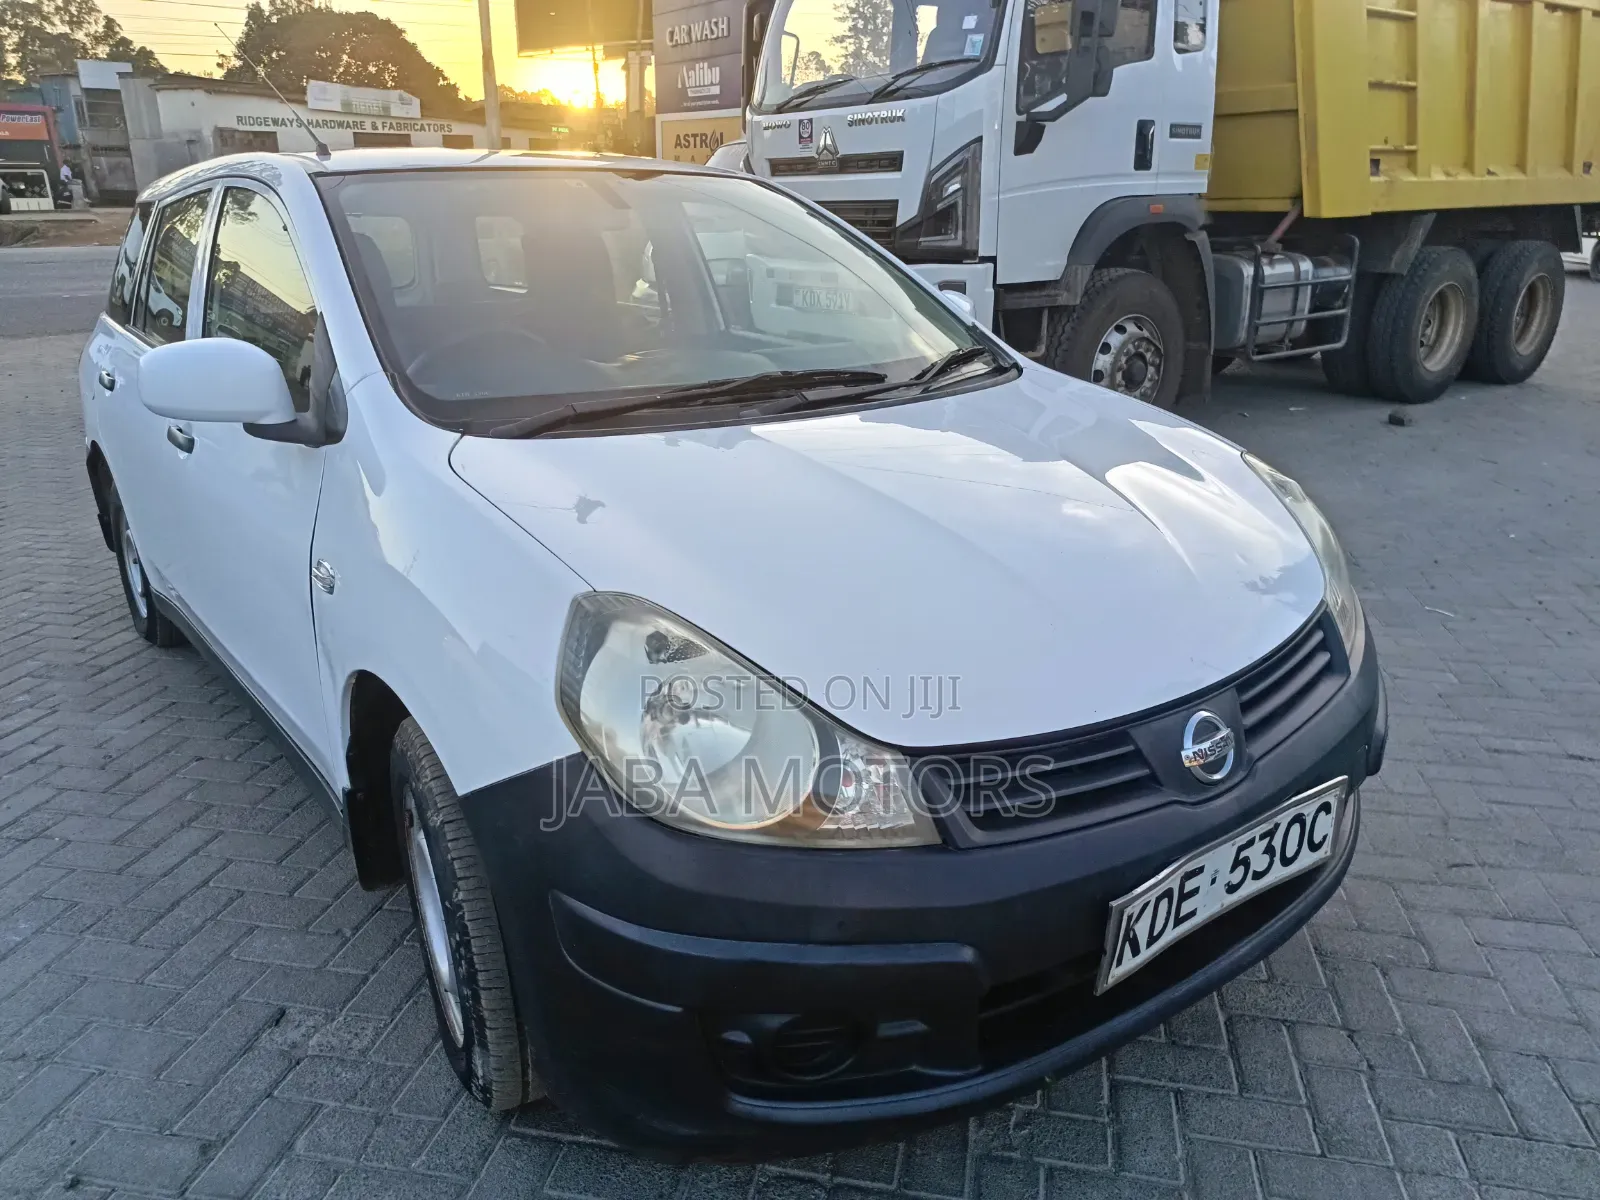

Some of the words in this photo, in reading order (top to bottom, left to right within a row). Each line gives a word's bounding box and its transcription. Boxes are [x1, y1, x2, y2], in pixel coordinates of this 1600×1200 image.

[666, 24, 690, 46] CAR
[690, 16, 729, 42] WASH
[678, 62, 720, 88] Malibu
[236, 115, 302, 128] RIDGEWAYS
[307, 118, 366, 131] HARDWARE
[371, 121, 379, 131] &
[382, 121, 453, 133] FABRICATORS
[801, 121, 811, 131] 80
[847, 108, 906, 128] SINOTRUK
[1191, 734, 1234, 762] NISSAN
[1115, 864, 1205, 968] KDE
[1224, 800, 1332, 895] 530C
